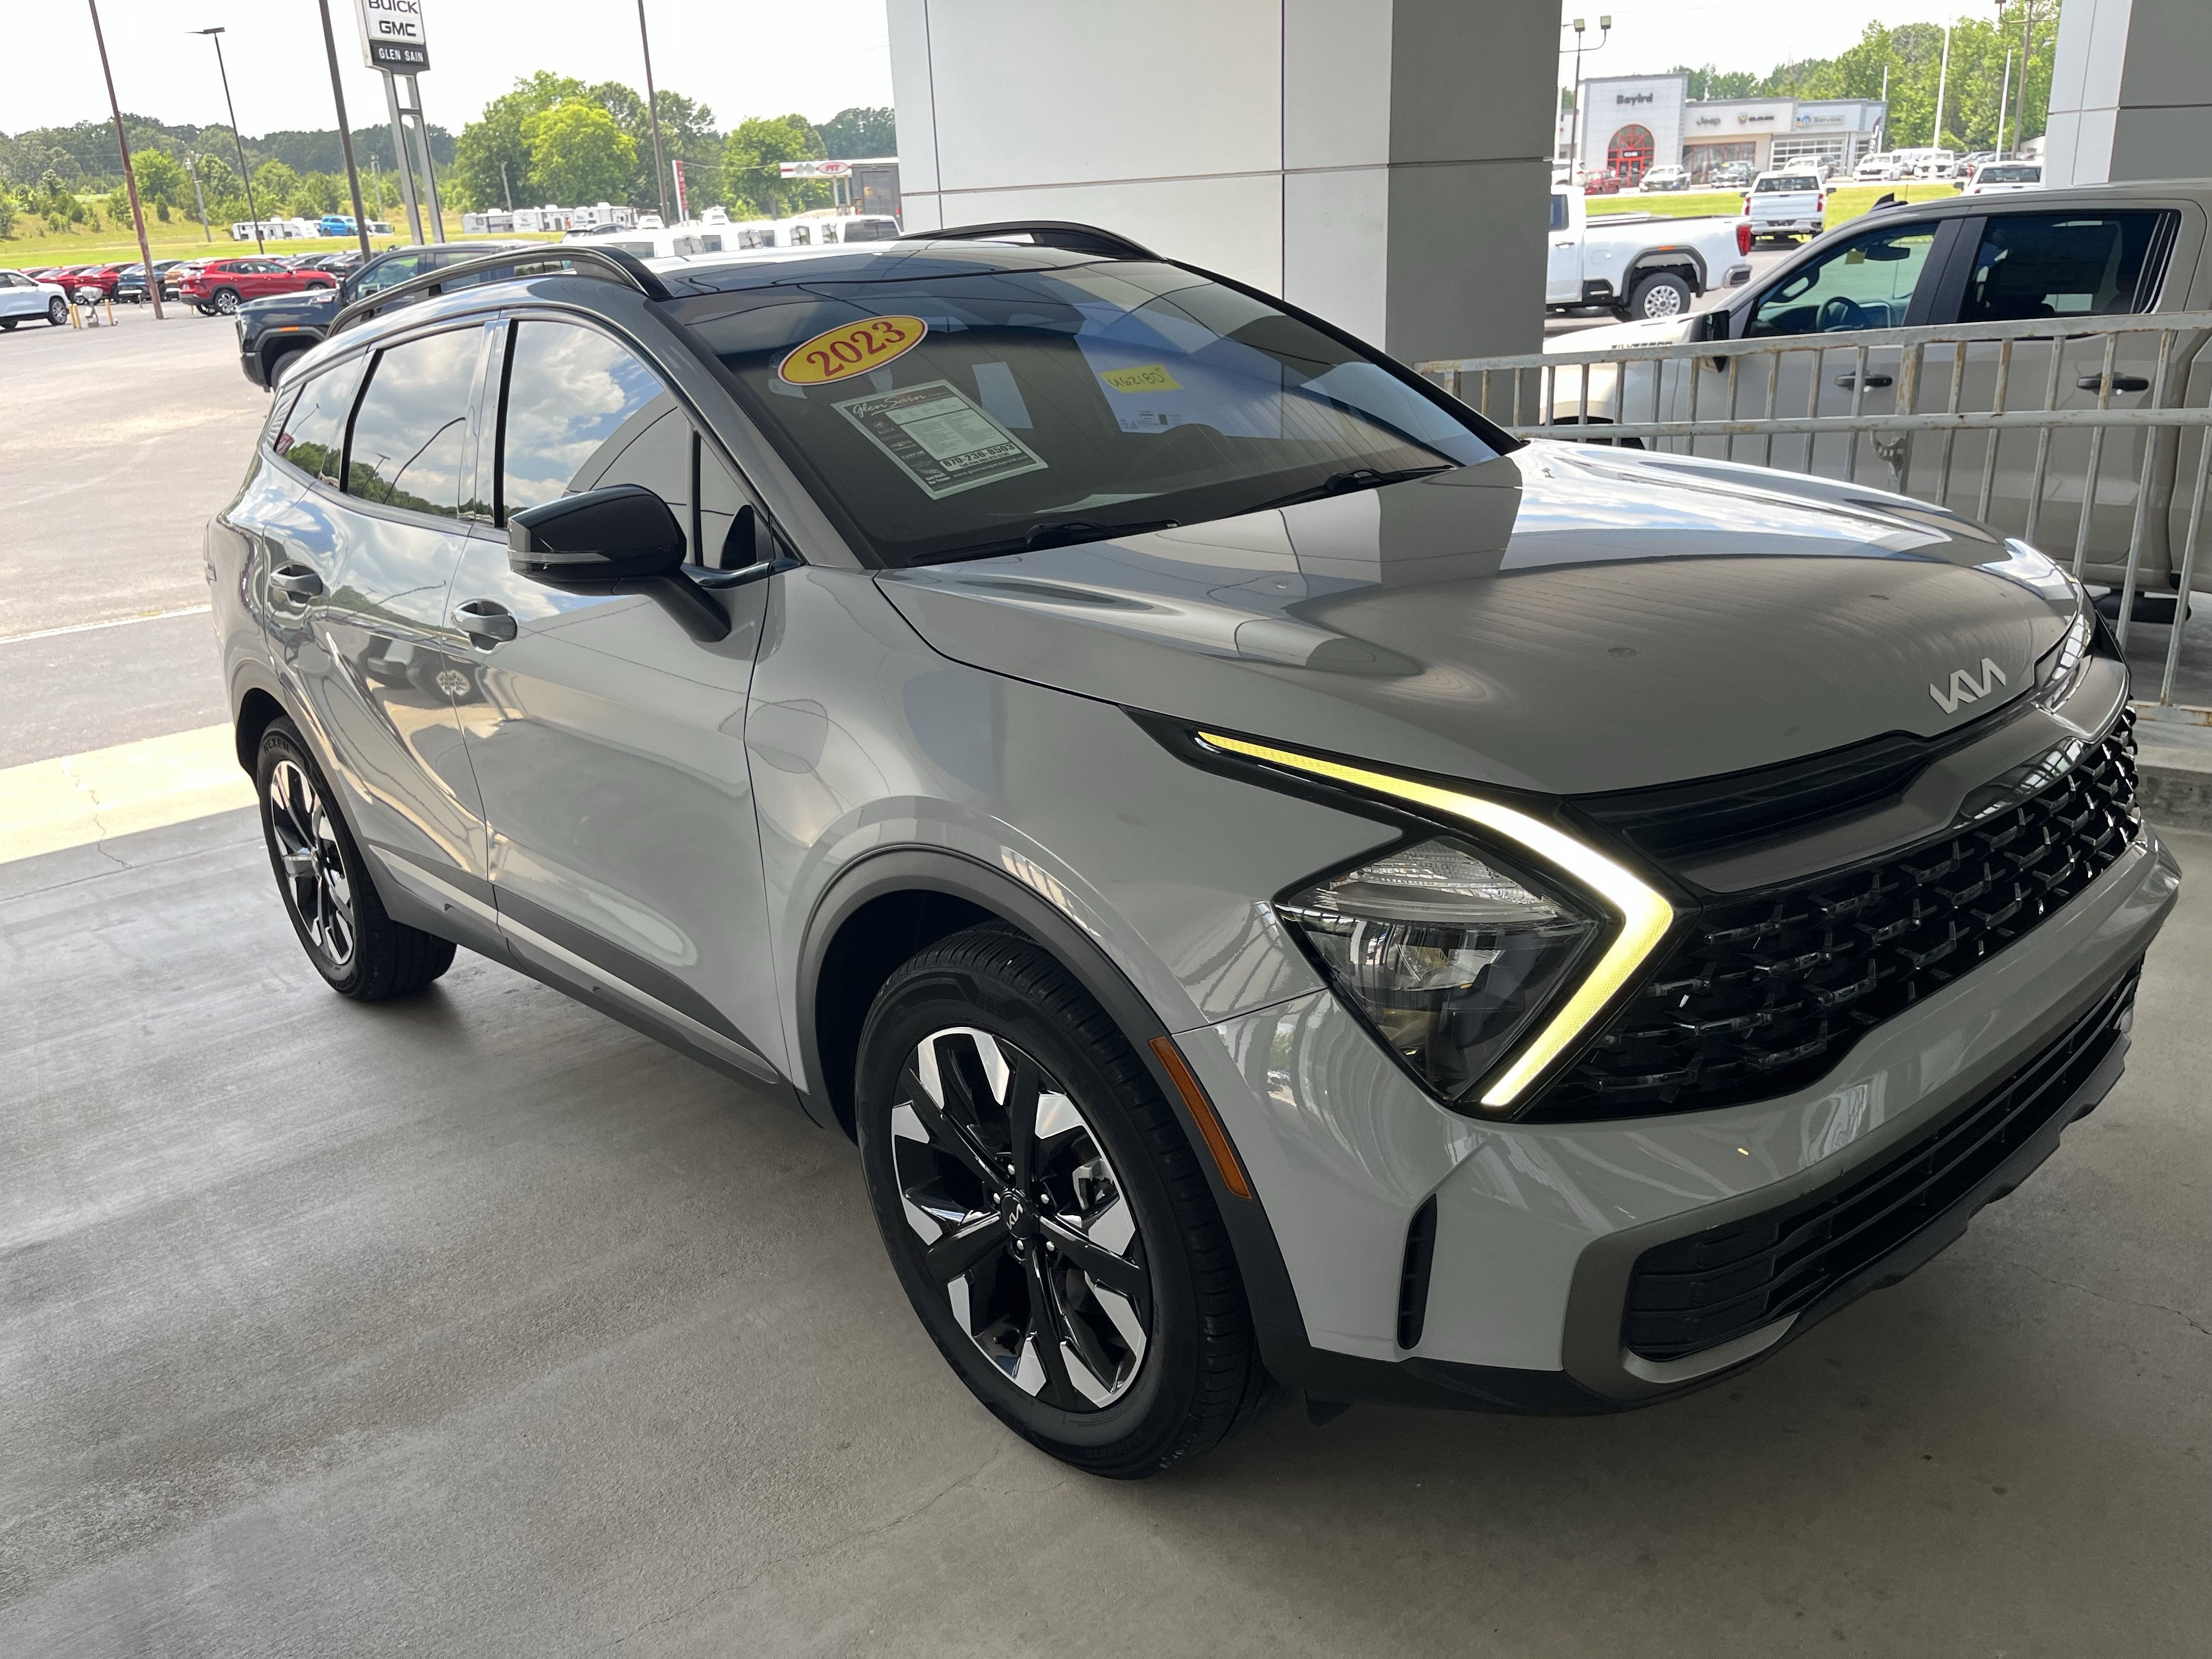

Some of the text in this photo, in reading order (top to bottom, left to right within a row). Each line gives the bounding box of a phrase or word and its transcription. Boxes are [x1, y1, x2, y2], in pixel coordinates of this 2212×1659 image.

[369, 0, 419, 14] BUICK
[379, 20, 416, 37] GMC
[379, 48, 424, 63] GLEN SAIN
[806, 321, 905, 377] 2023
[853, 403, 888, 419] Glen
[884, 393, 926, 408] Sain
[943, 443, 1015, 467] 870-236-8503
[263, 737, 290, 754] NEXEN
